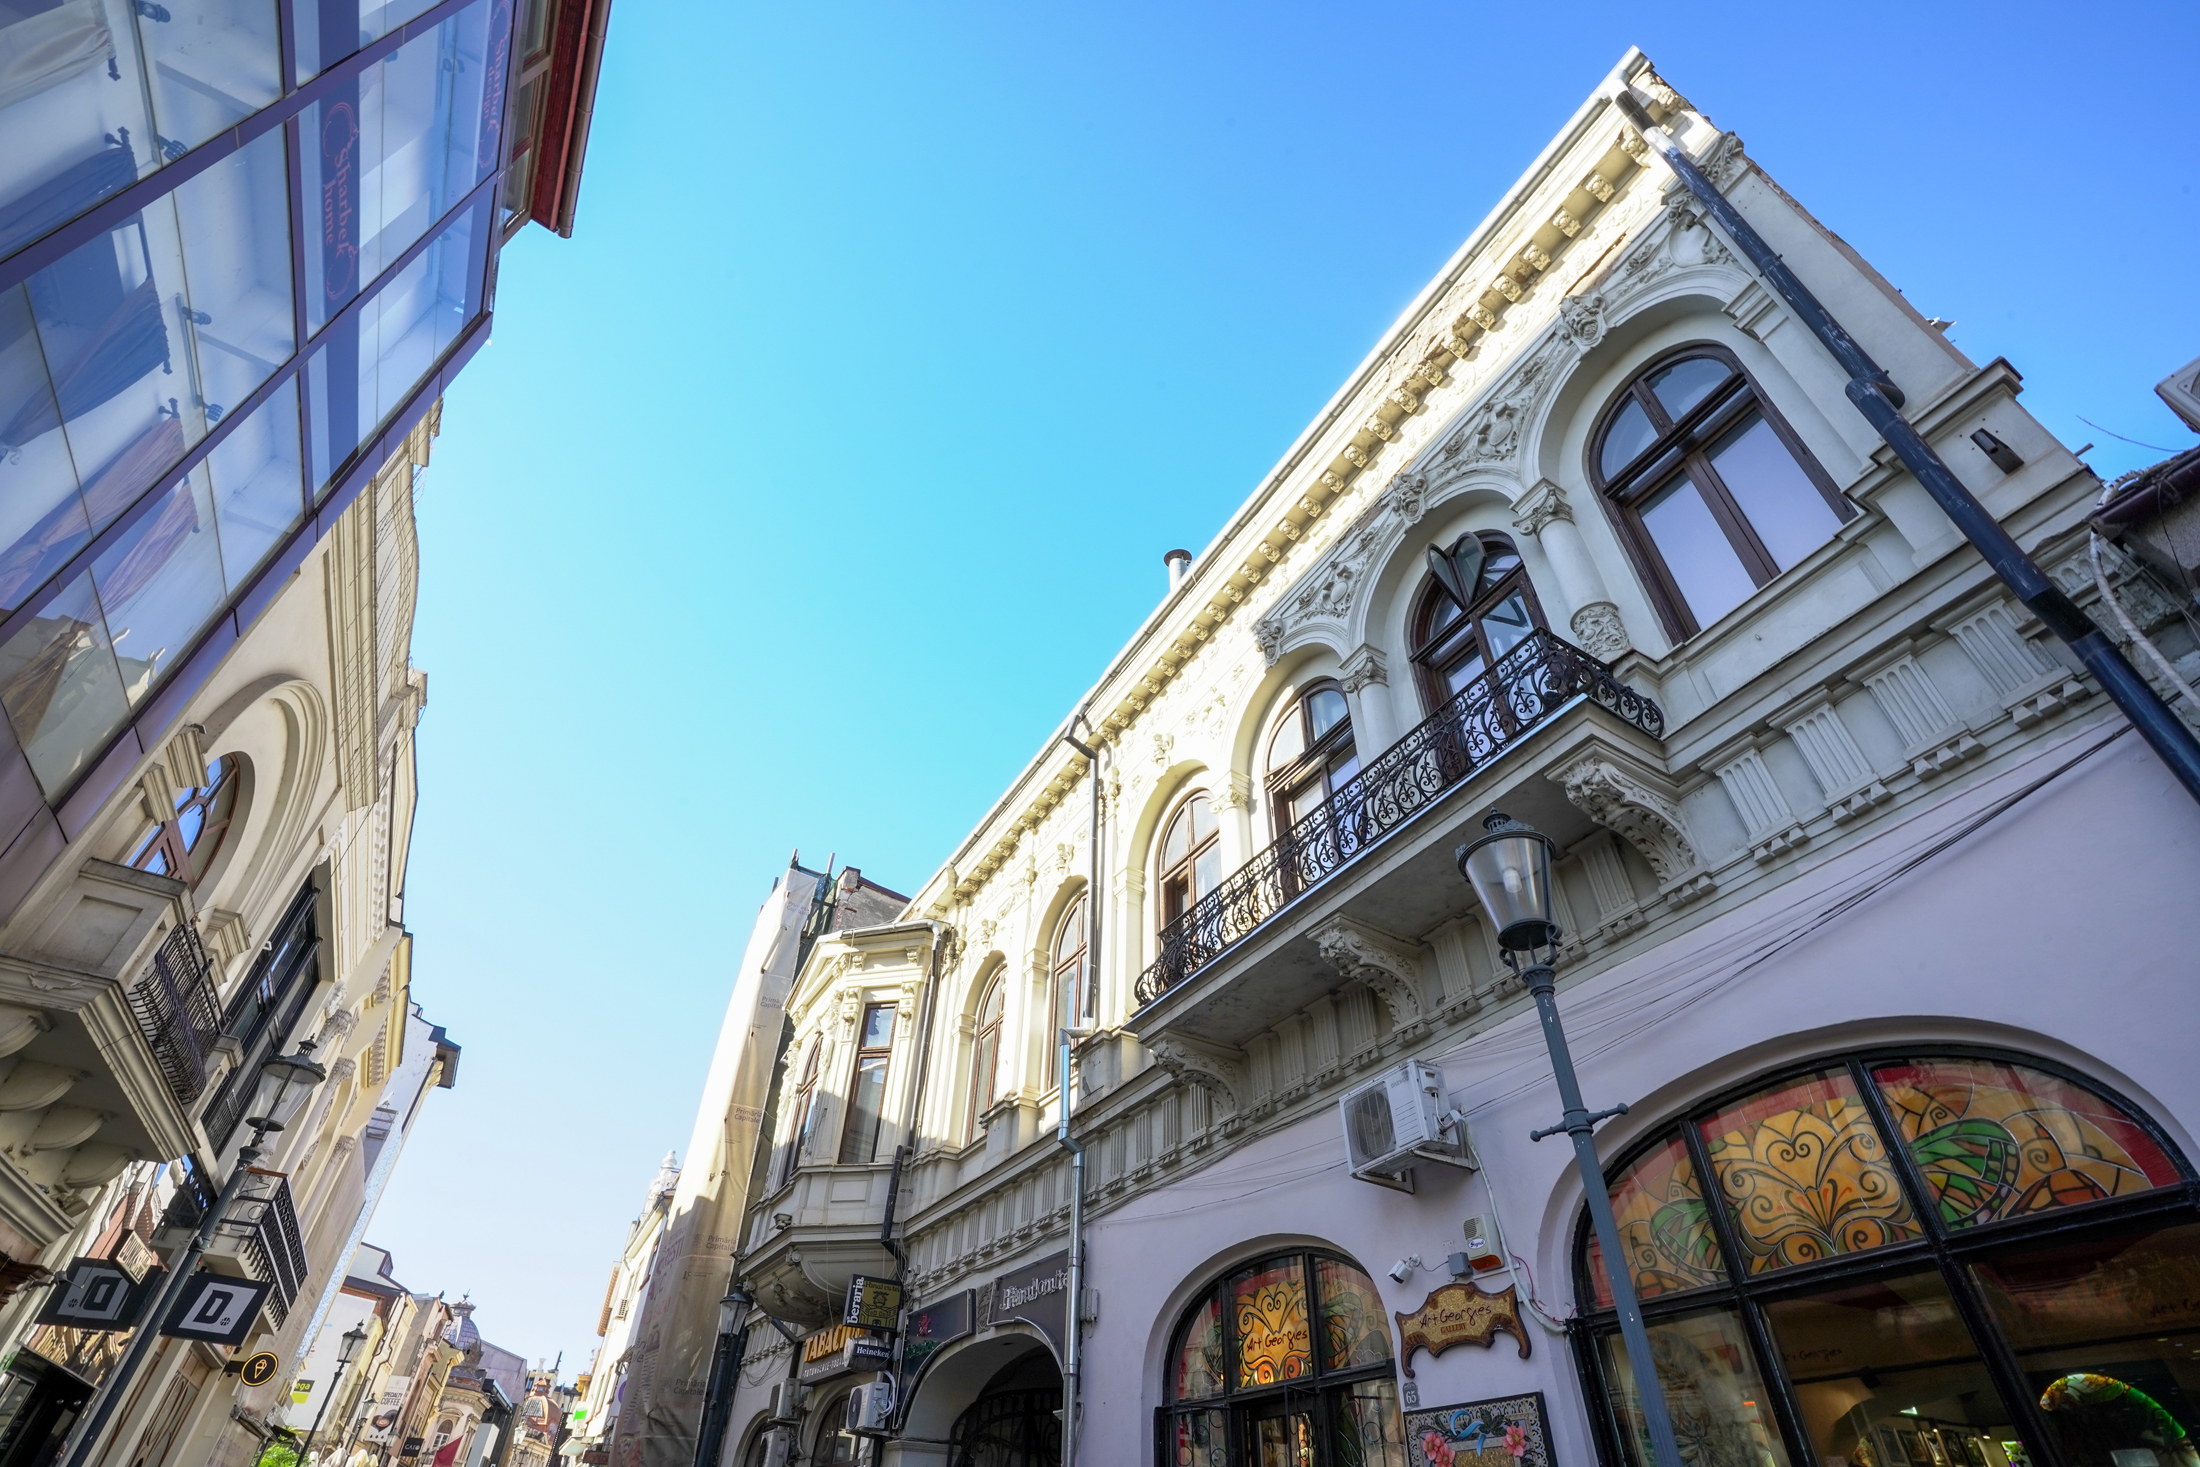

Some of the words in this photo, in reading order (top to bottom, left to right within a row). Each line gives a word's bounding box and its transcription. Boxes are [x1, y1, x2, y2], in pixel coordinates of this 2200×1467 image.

[324, 179, 337, 246] home
[335, 147, 352, 259] Sharbek
[847, 1277, 865, 1324] beraria
[1420, 1314, 1438, 1329] Art
[1440, 1305, 1492, 1326] Georgies
[1440, 1322, 1467, 1334] GALLERY
[857, 1346, 890, 1358] Heineken
[1247, 1337, 1262, 1353] Art
[1265, 1330, 1308, 1350] Georgies
[295, 1382, 311, 1391] ega
[1406, 1390, 1417, 1404] 65
